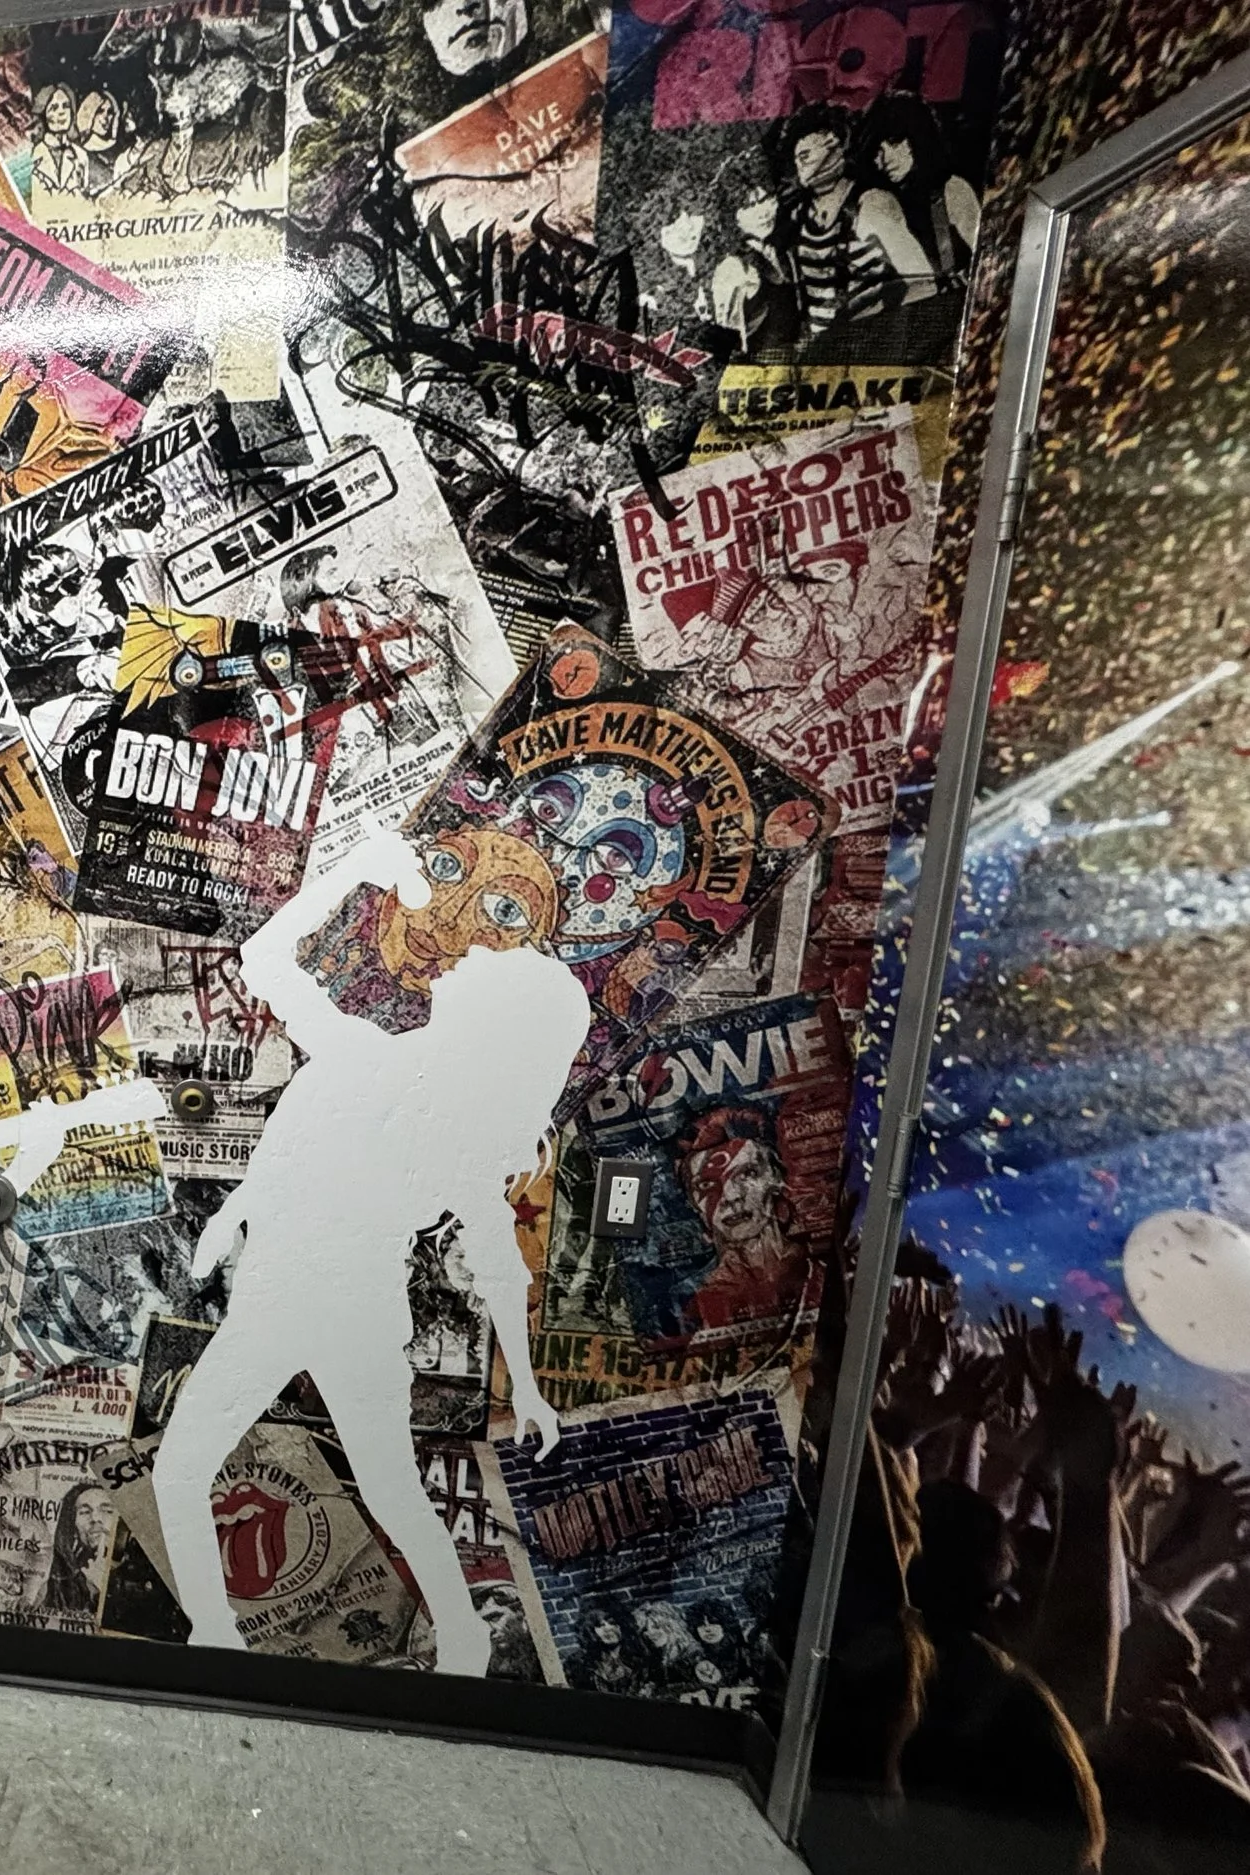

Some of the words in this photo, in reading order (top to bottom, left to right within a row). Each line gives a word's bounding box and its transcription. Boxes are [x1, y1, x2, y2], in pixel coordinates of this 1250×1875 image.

[496, 102, 563, 152] DAVE
[720, 376, 924, 418] TESNAKE
[54, 454, 134, 521] YOUTH
[140, 420, 192, 474] LIVE
[622, 487, 732, 564] RED
[728, 431, 898, 517] HOT
[210, 478, 348, 576] ELVIS
[736, 469, 914, 572] PEPPERS
[67, 720, 108, 762] PORTLA
[512, 711, 590, 768] DAVE
[599, 711, 740, 811] MATTHEWS
[105, 728, 208, 812] BON
[211, 748, 318, 832] JOVI
[332, 772, 391, 808] PONTIAC
[391, 741, 455, 779] STADIUM
[834, 774, 894, 810] NIG
[96, 831, 115, 855] 19
[147, 830, 197, 849] STADIUM
[267, 851, 296, 869] 8:30
[126, 865, 178, 889] READY
[181, 873, 199, 895] TO
[202, 881, 250, 904] ROCK!
[144, 846, 188, 869] KUALA
[192, 853, 248, 881] LUMPUR
[588, 1015, 833, 1124] BOWIE
[159, 1140, 205, 1158] MUSIC
[208, 1143, 256, 1161] STOR
[530, 1334, 592, 1372] UNE
[41, 1362, 128, 1388] APRILE
[21, 1424, 48, 1435] NOW
[244, 1461, 318, 1508] STONES
[11, 1496, 62, 1524] MARLEY
[273, 1550, 324, 1595] JANUARY
[313, 1511, 329, 1548] 2014
[236, 1612, 273, 1637] RDAY
[293, 1589, 321, 1613] 2PM
[353, 1563, 389, 1588] 7PM
